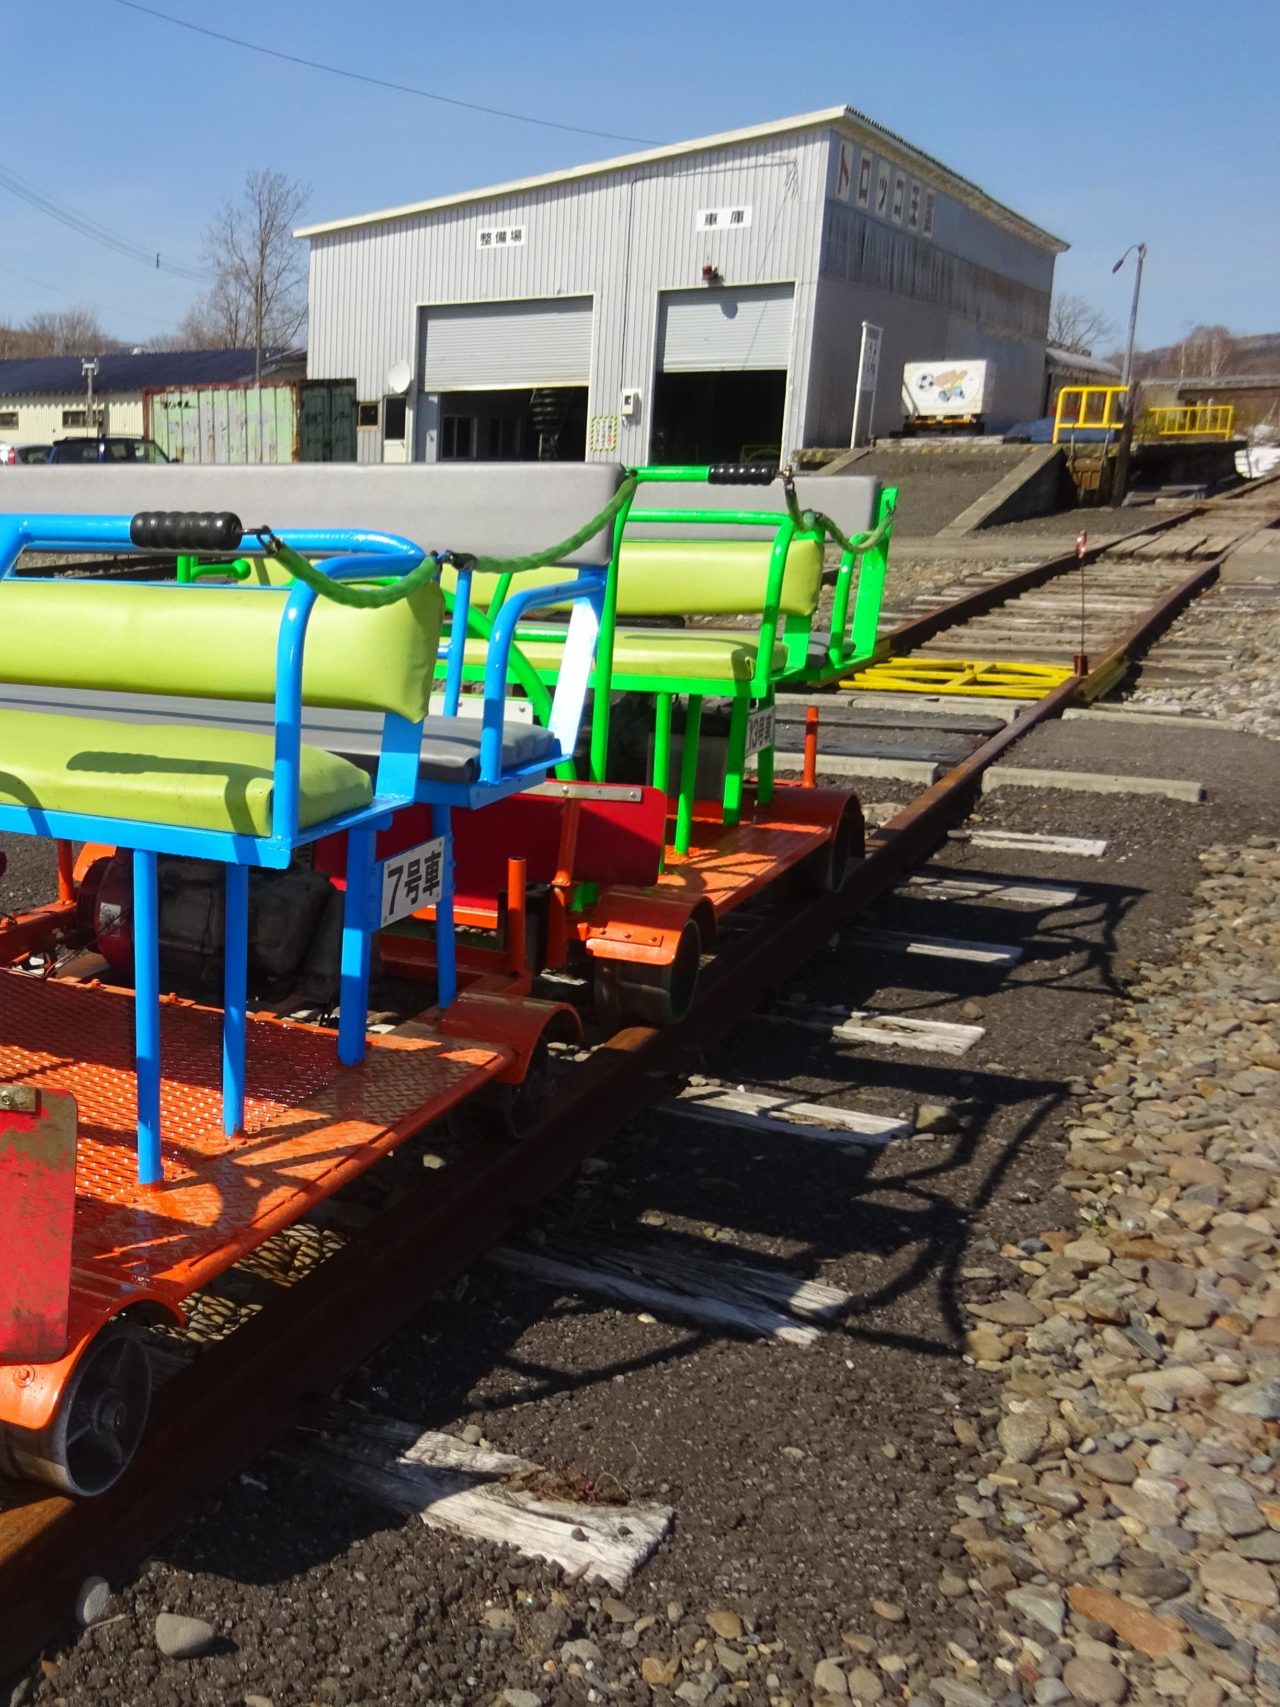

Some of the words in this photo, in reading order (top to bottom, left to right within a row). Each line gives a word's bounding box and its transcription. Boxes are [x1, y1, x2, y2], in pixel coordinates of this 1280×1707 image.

[704, 210, 745, 227] 車庫
[480, 229, 522, 246] 整備場
[387, 850, 442, 915] 7号車
